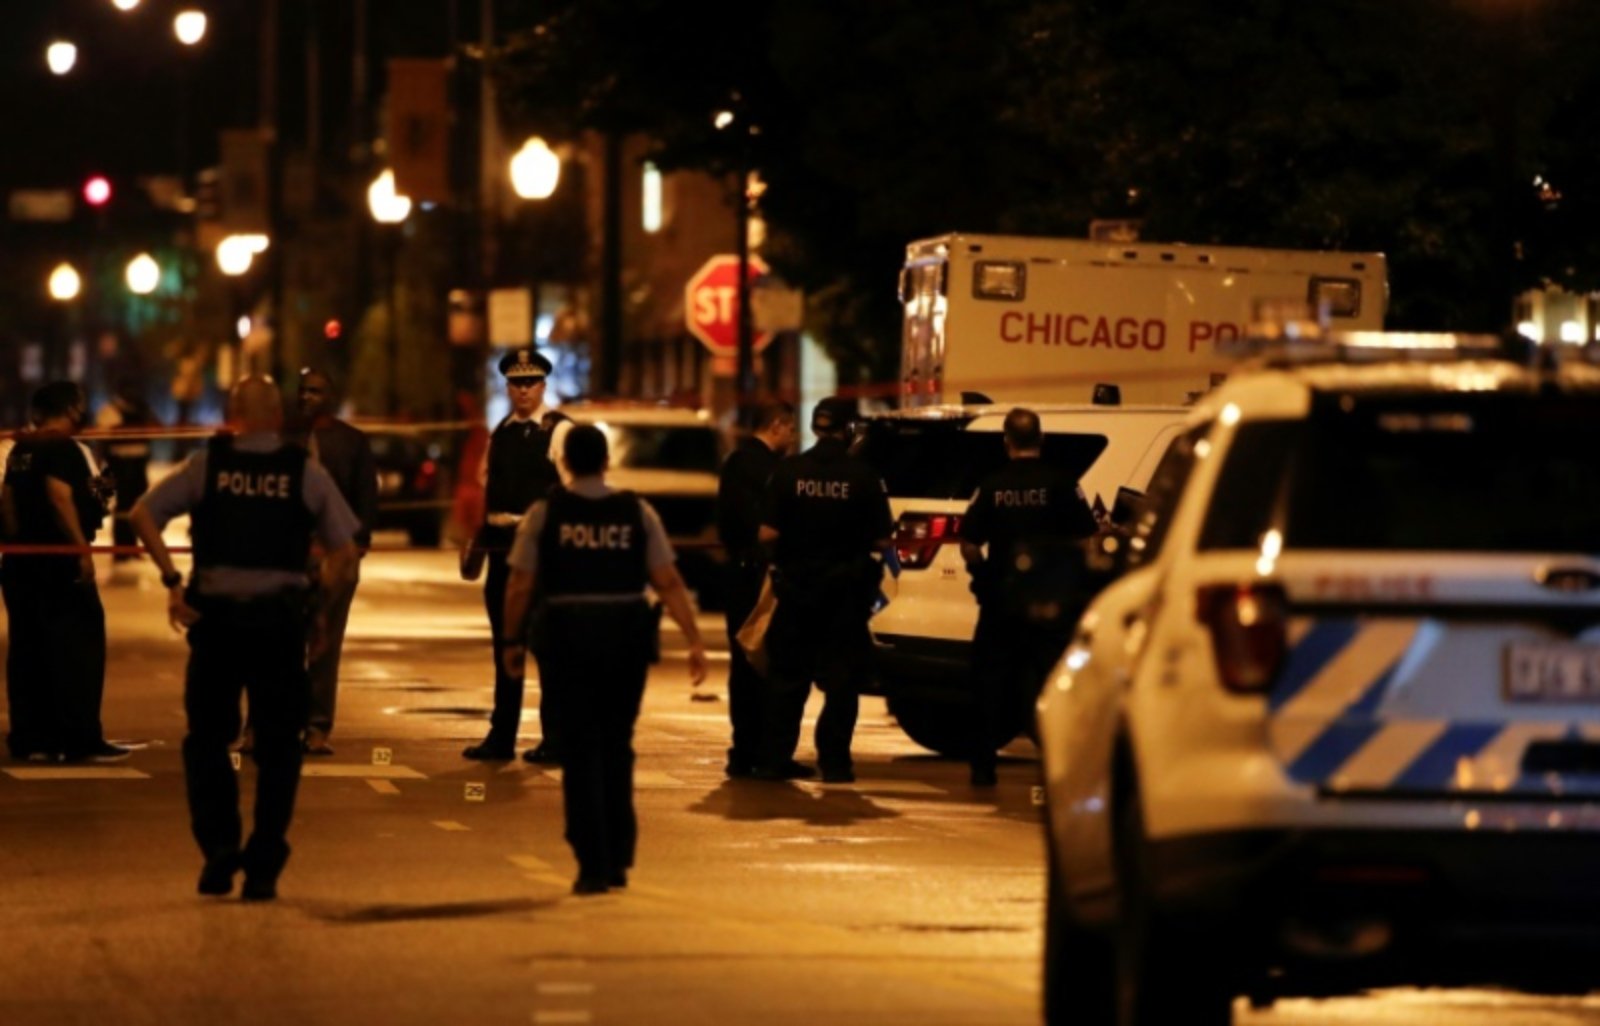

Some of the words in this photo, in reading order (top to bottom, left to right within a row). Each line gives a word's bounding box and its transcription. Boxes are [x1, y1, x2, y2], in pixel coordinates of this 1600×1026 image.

[697, 287, 737, 323] ST
[1000, 311, 1166, 351] CHICAGO
[1188, 321, 1246, 353] PO
[217, 471, 290, 498] POLICE
[796, 479, 849, 500] POLICE
[995, 487, 1048, 507] POLICE
[560, 523, 632, 550] POLICE
